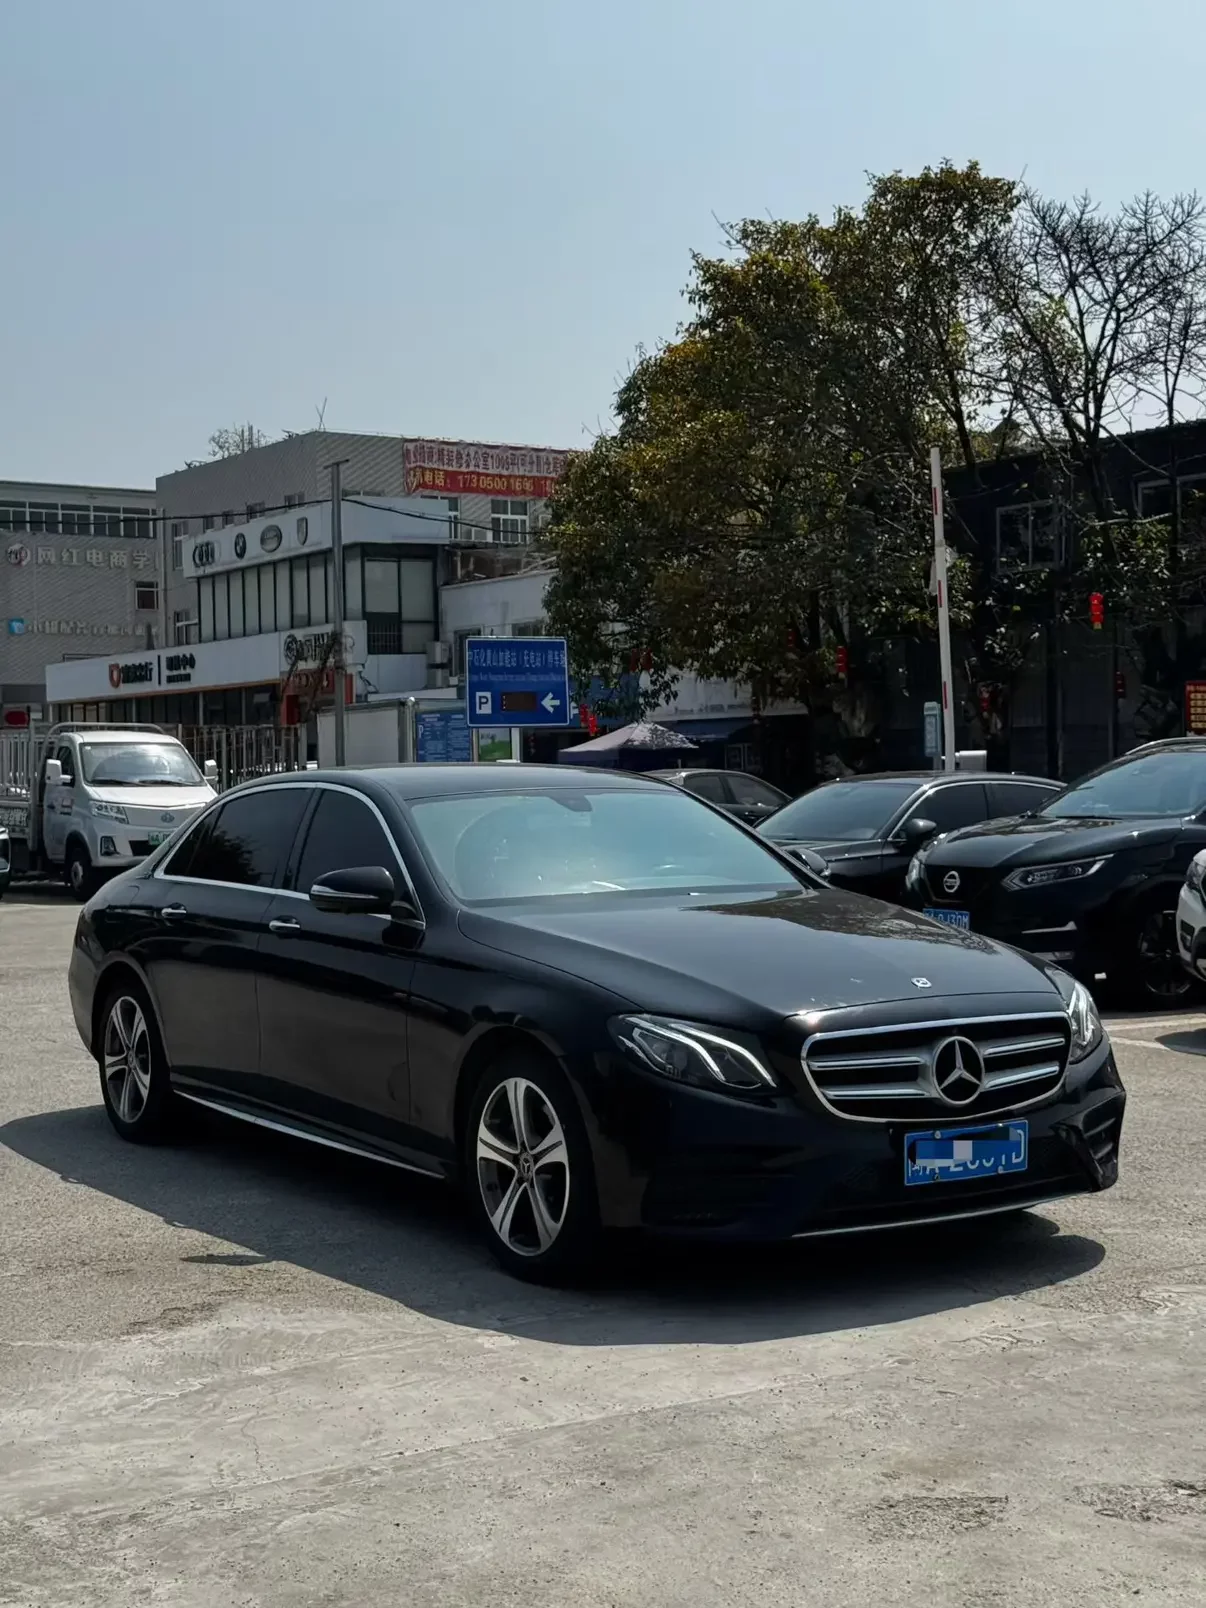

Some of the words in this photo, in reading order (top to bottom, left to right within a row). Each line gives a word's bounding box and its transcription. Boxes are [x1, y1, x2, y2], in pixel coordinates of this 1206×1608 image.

[37, 545, 159, 570] 网红电商学
[478, 696, 489, 710] P
